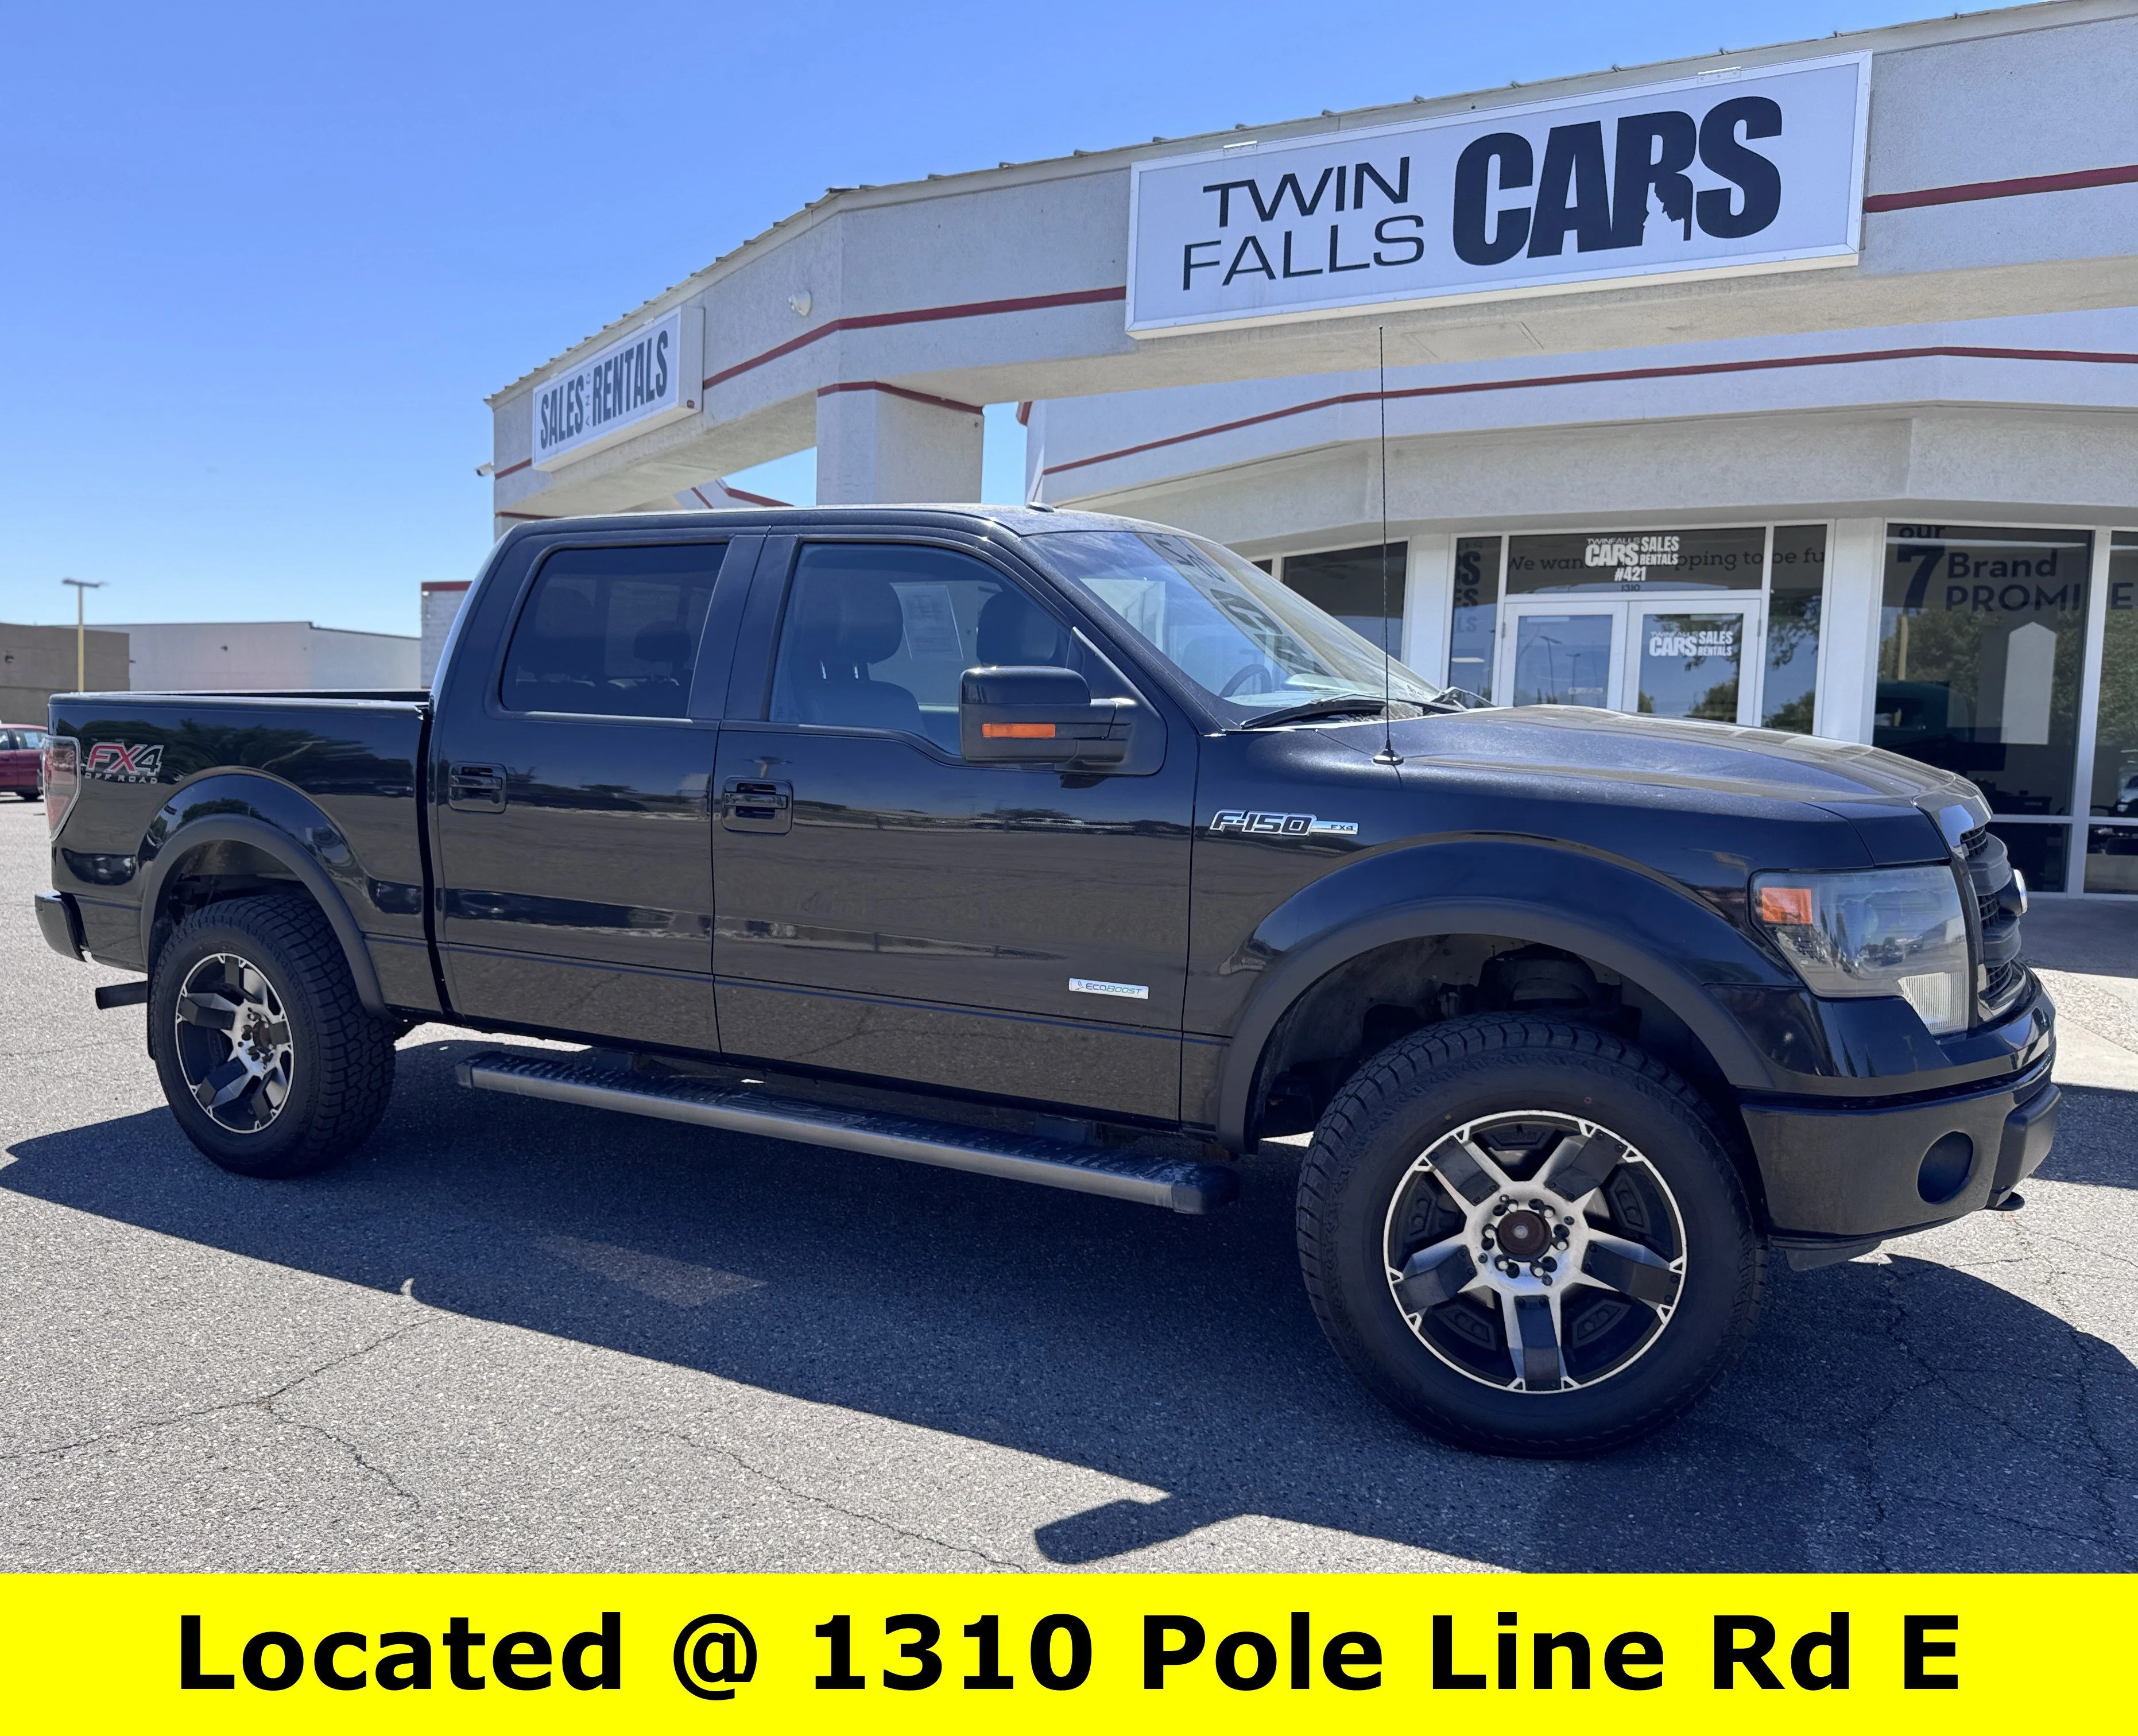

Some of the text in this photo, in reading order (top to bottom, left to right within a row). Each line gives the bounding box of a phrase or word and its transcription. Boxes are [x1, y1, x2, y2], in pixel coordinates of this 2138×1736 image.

[1453, 95, 1783, 266] CARS
[1202, 156, 1410, 228] TWIN
[1183, 215, 1424, 291] FALLS
[540, 375, 584, 450] SALES
[592, 330, 668, 427] RENTALS
[1898, 525, 1946, 538] our
[1641, 536, 1680, 552] SALES
[1508, 556, 1535, 570] We
[1540, 557, 1590, 570] wan
[1743, 551, 1764, 564] to
[1585, 543, 1639, 567] CARS
[1639, 553, 1679, 565] RENTALS
[1614, 566, 1647, 582] #421
[1896, 544, 2058, 609] 7 Brand
[1621, 584, 1641, 592] 1310
[1649, 636, 1698, 657] CARS
[1698, 631, 1733, 645] SALES
[1698, 646, 1732, 656] RENTALS
[86, 742, 164, 777] FX4
[84, 772, 158, 784] OFF ROAD
[1209, 808, 1317, 836] F-150
[1086, 983, 1142, 995] ECOBOOST
